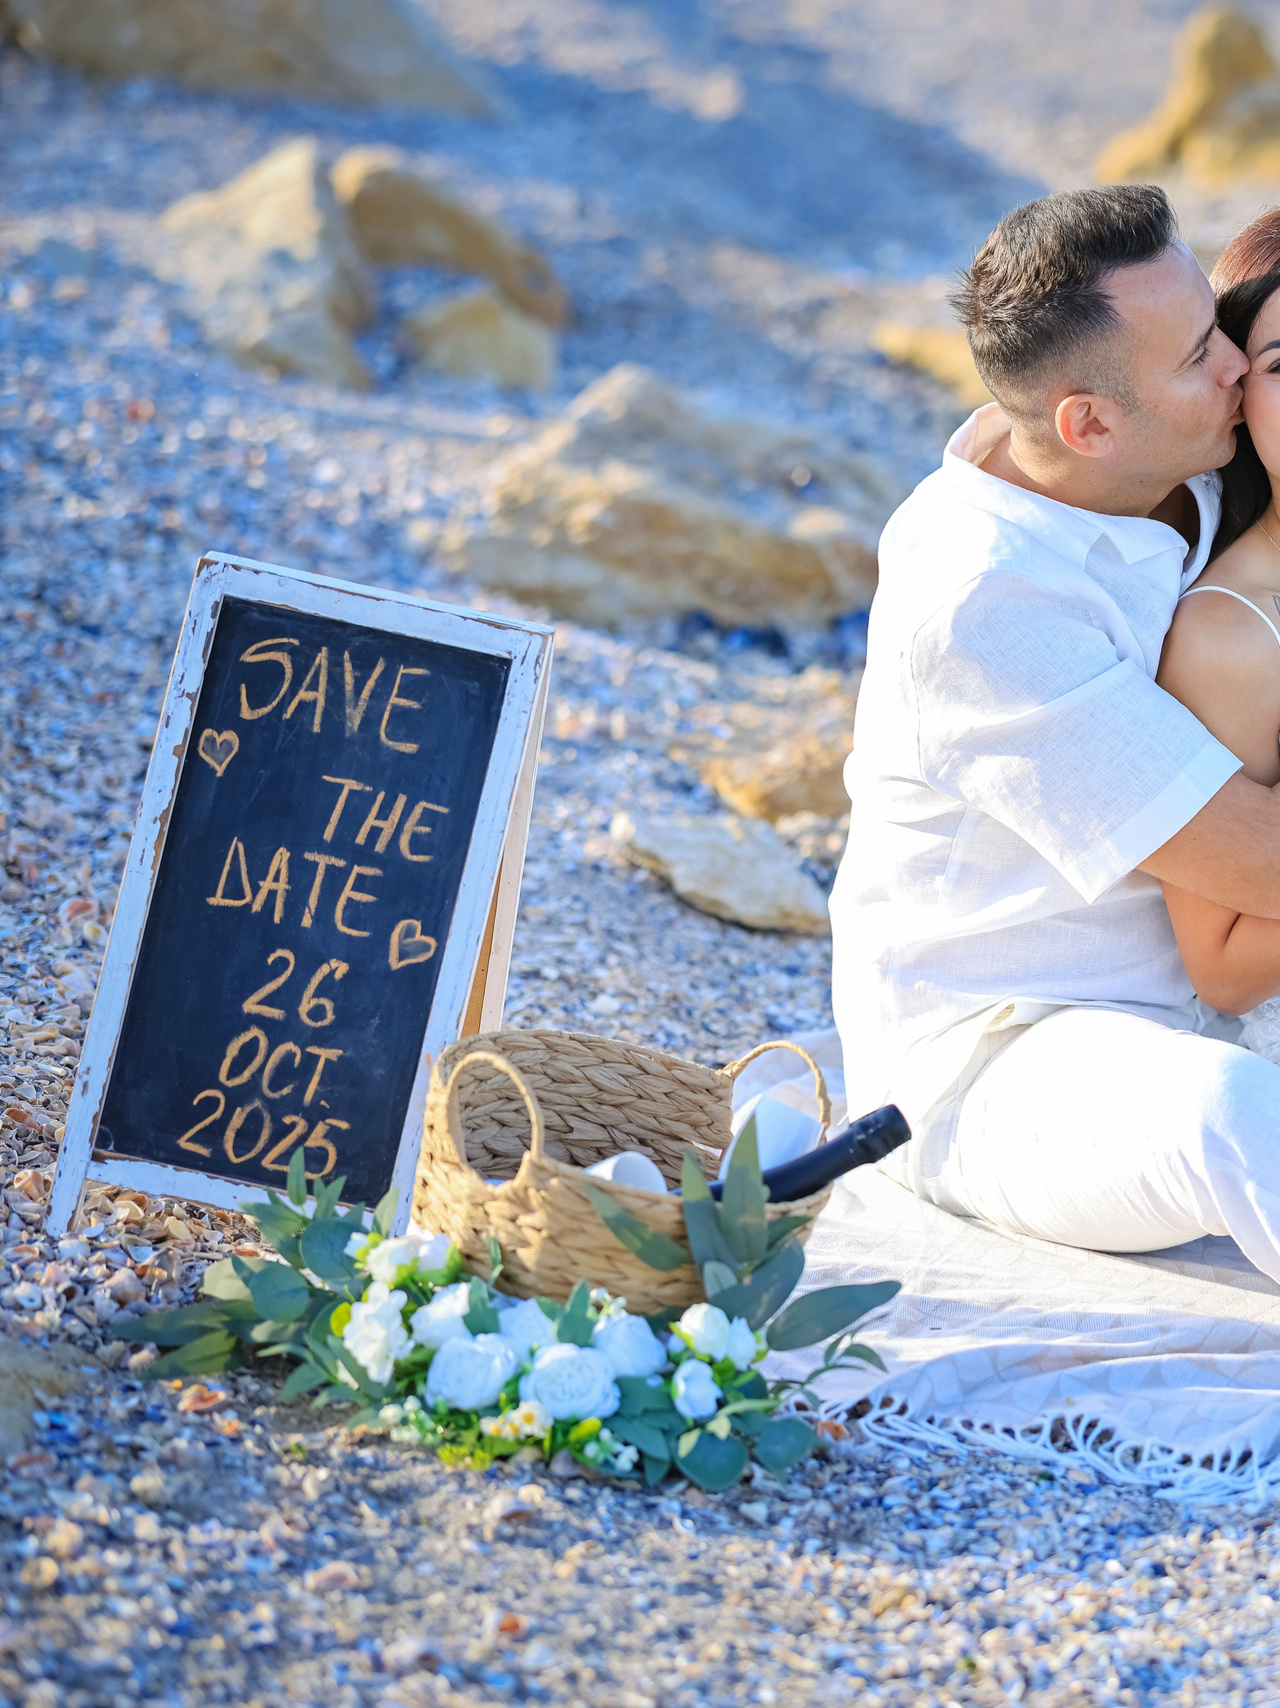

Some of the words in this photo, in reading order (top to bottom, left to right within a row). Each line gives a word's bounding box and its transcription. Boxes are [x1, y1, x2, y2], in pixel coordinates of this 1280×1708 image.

[238, 636, 432, 755] SAVE
[321, 774, 450, 862] THE
[205, 836, 385, 938] DATE
[242, 948, 350, 1028] 26
[176, 1087, 351, 1181] 2025
